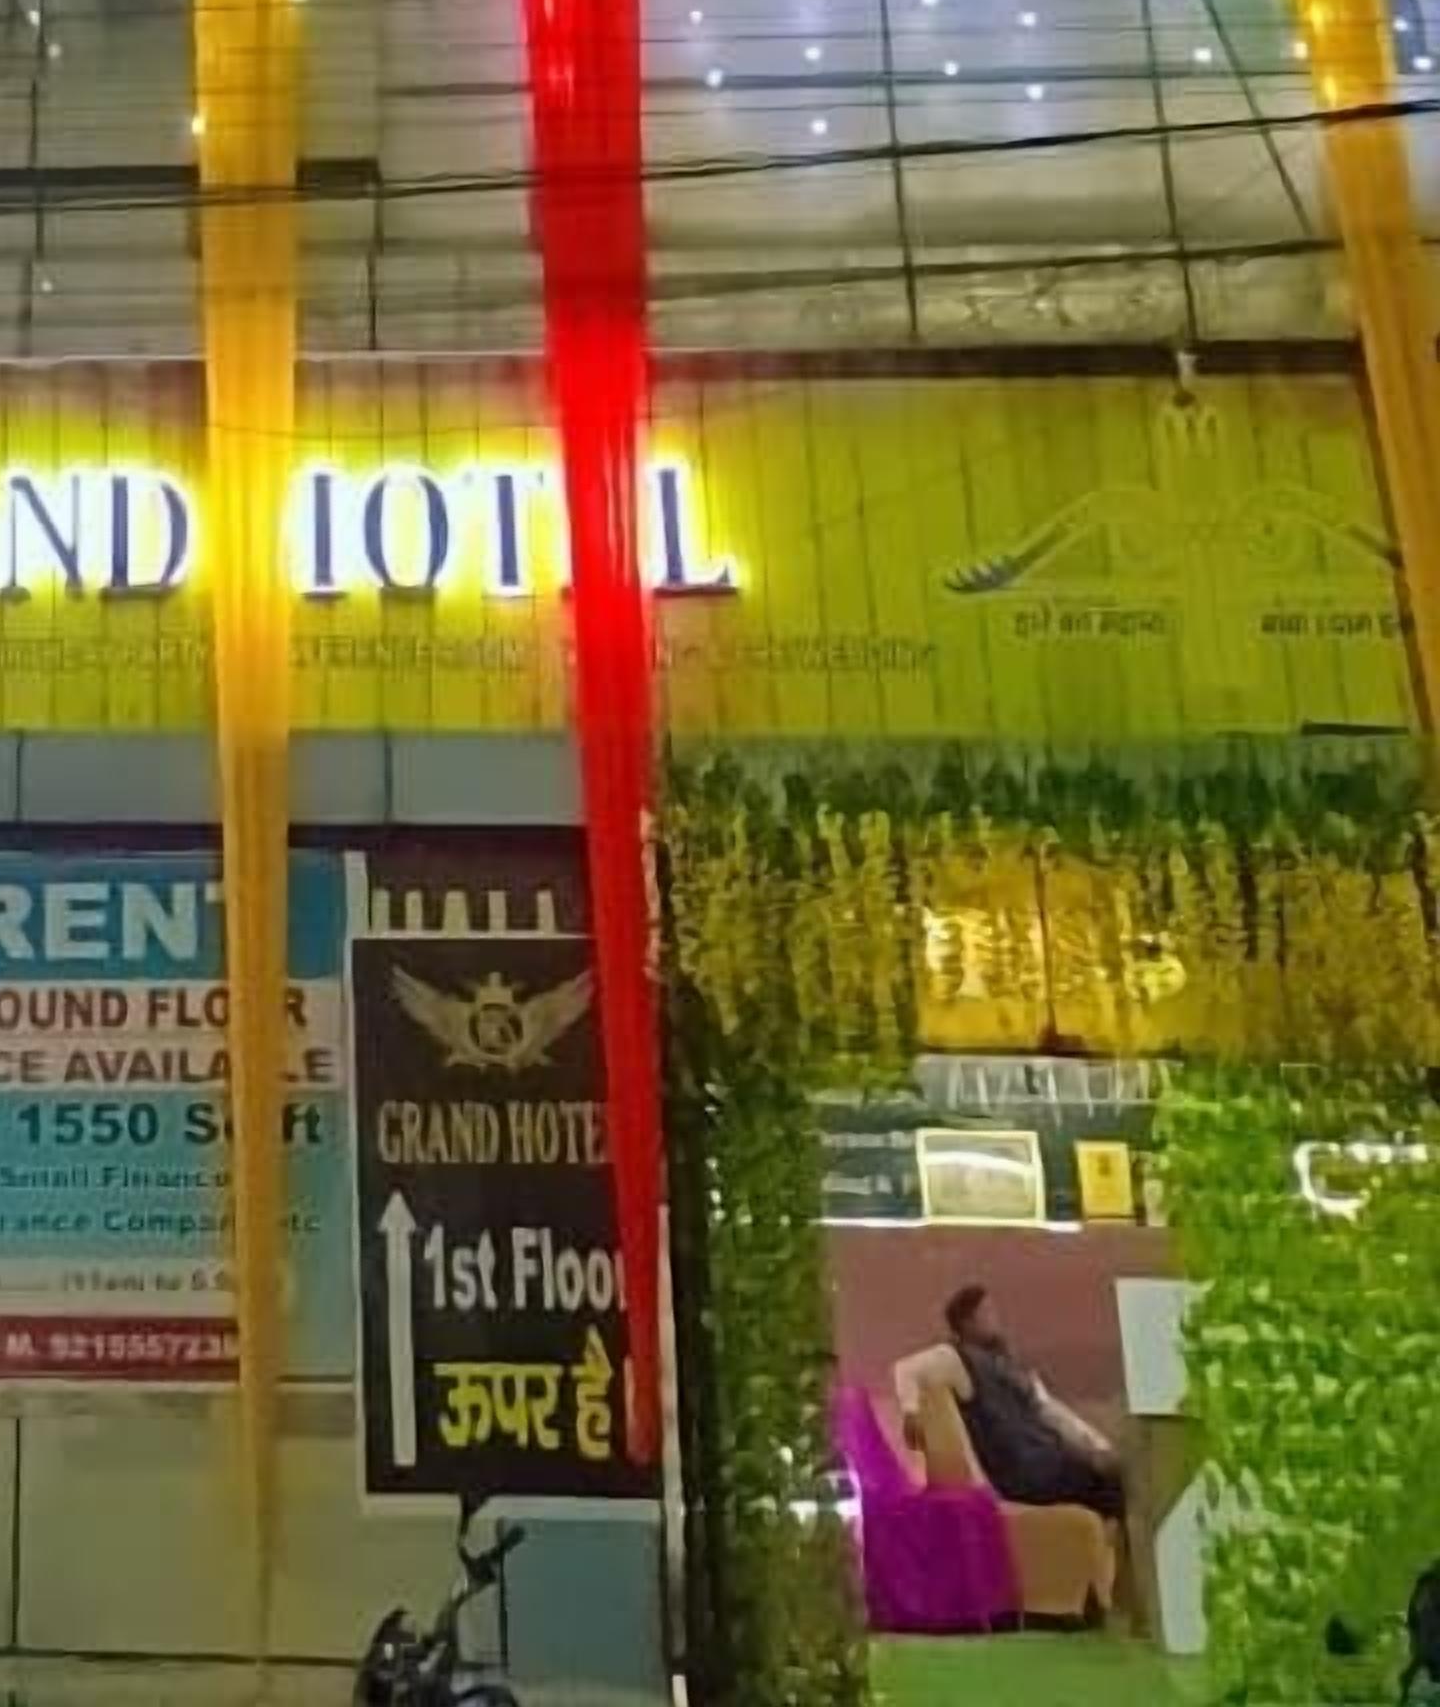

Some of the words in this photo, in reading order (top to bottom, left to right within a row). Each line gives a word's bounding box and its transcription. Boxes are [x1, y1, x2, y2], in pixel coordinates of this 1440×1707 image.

[147, 989, 308, 1029] FLOR
[17, 1101, 160, 1145] 1550
[378, 1100, 499, 1165] GRAND
[423, 1224, 497, 1310] 1st
[433, 1361, 563, 1449] ऊपर
